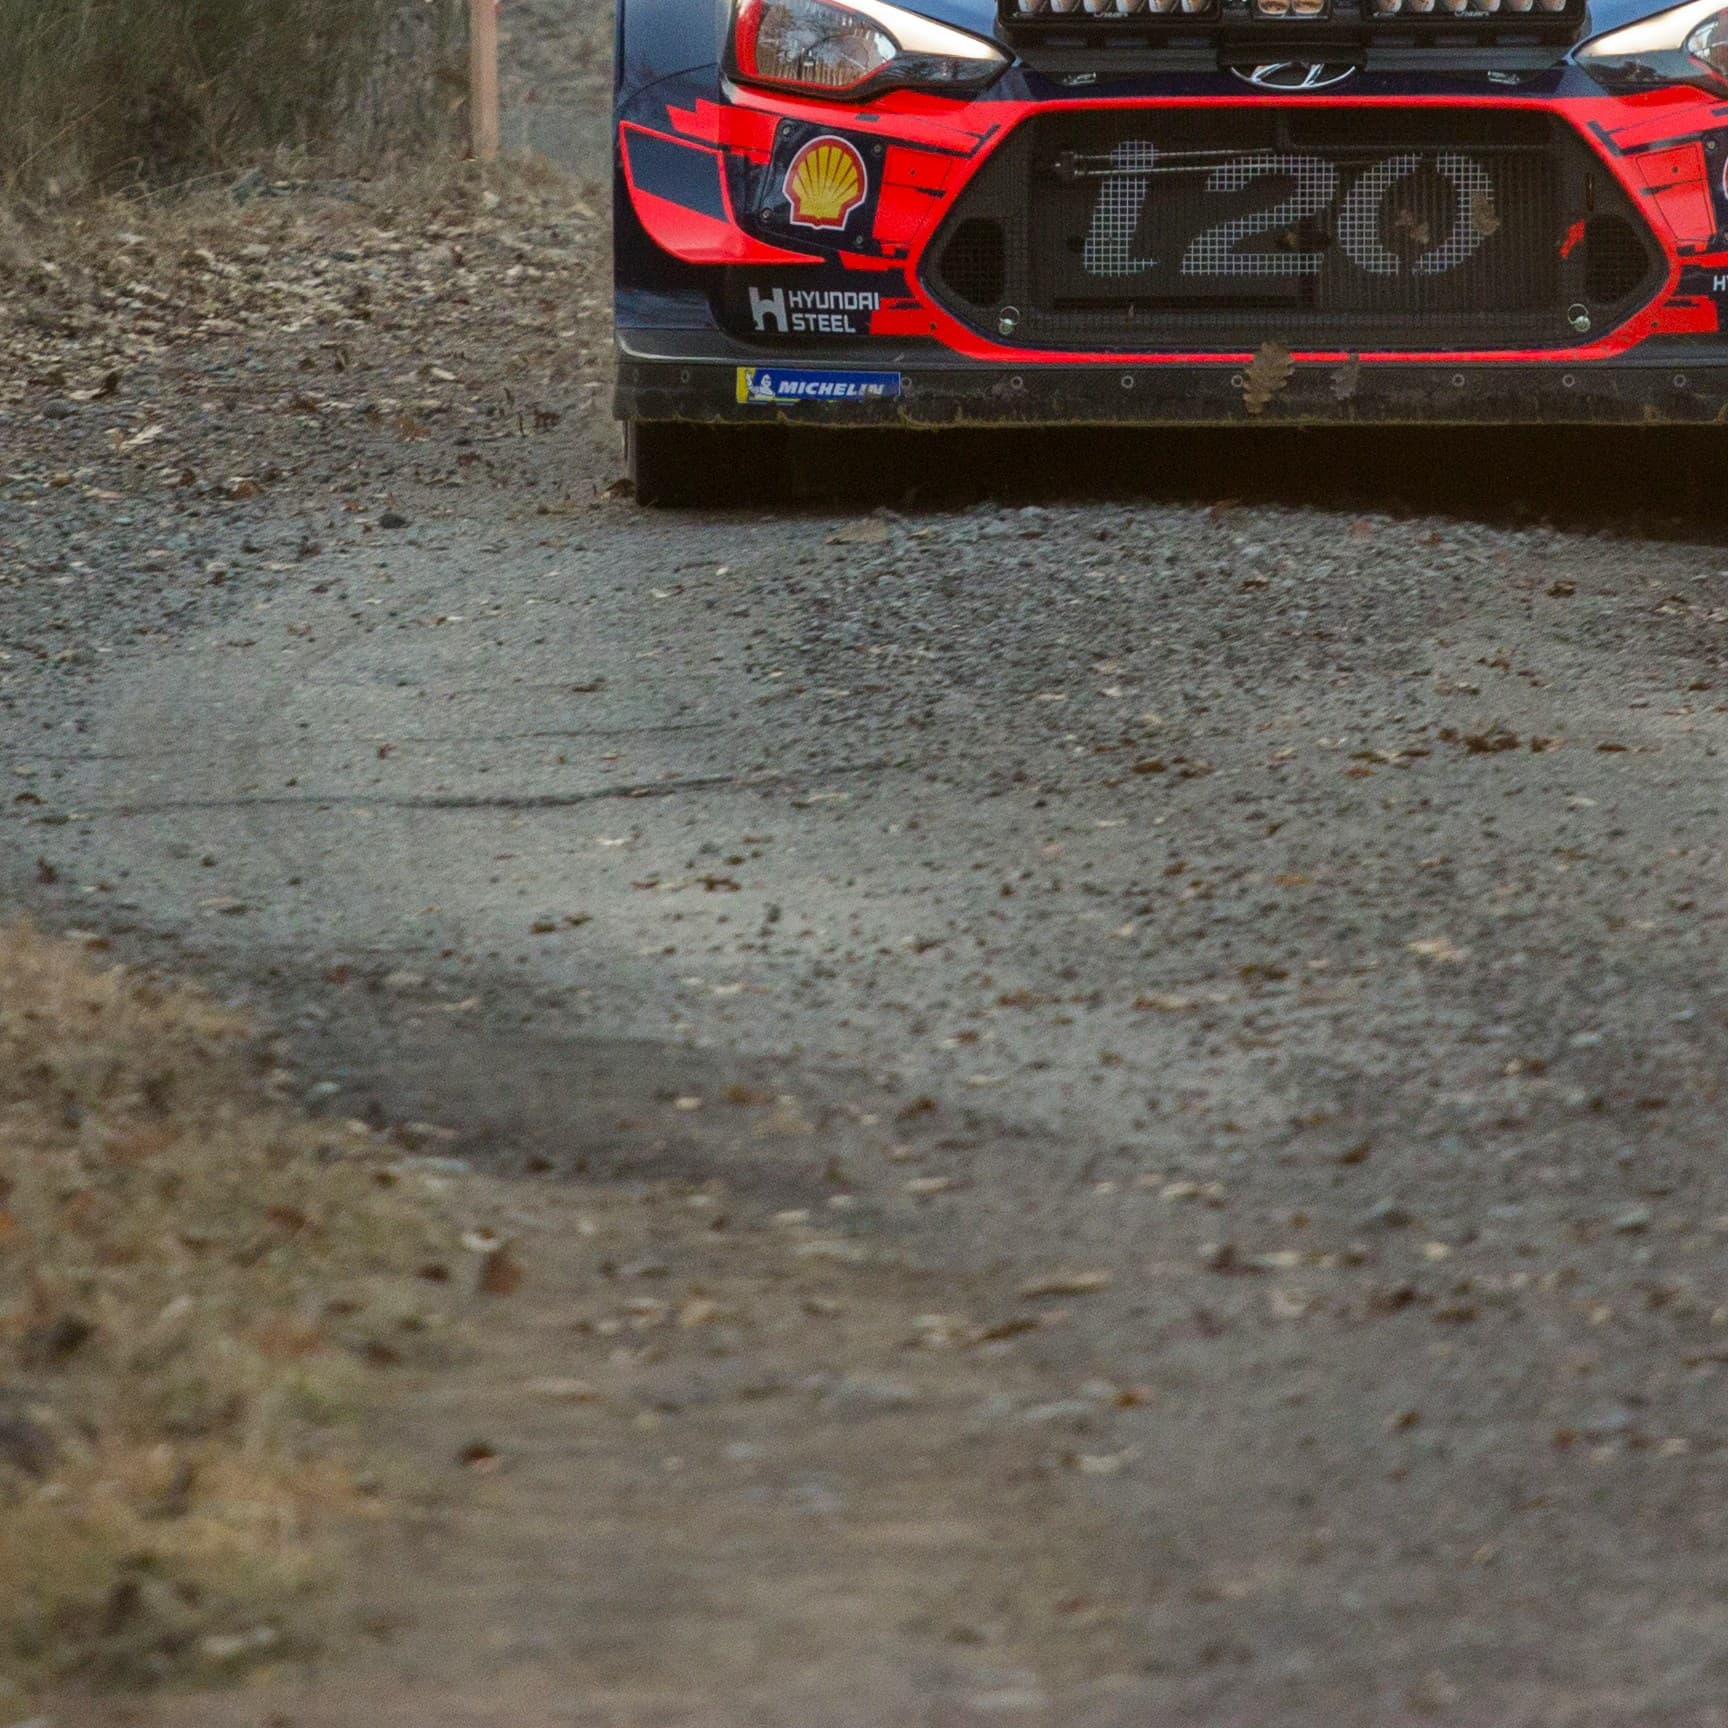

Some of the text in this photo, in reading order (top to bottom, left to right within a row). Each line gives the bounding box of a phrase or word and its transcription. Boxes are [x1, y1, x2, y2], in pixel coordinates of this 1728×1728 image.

[788, 290, 880, 311] HYUNDAI
[791, 313, 857, 334] STEEL
[777, 380, 885, 397] MICHELIN
